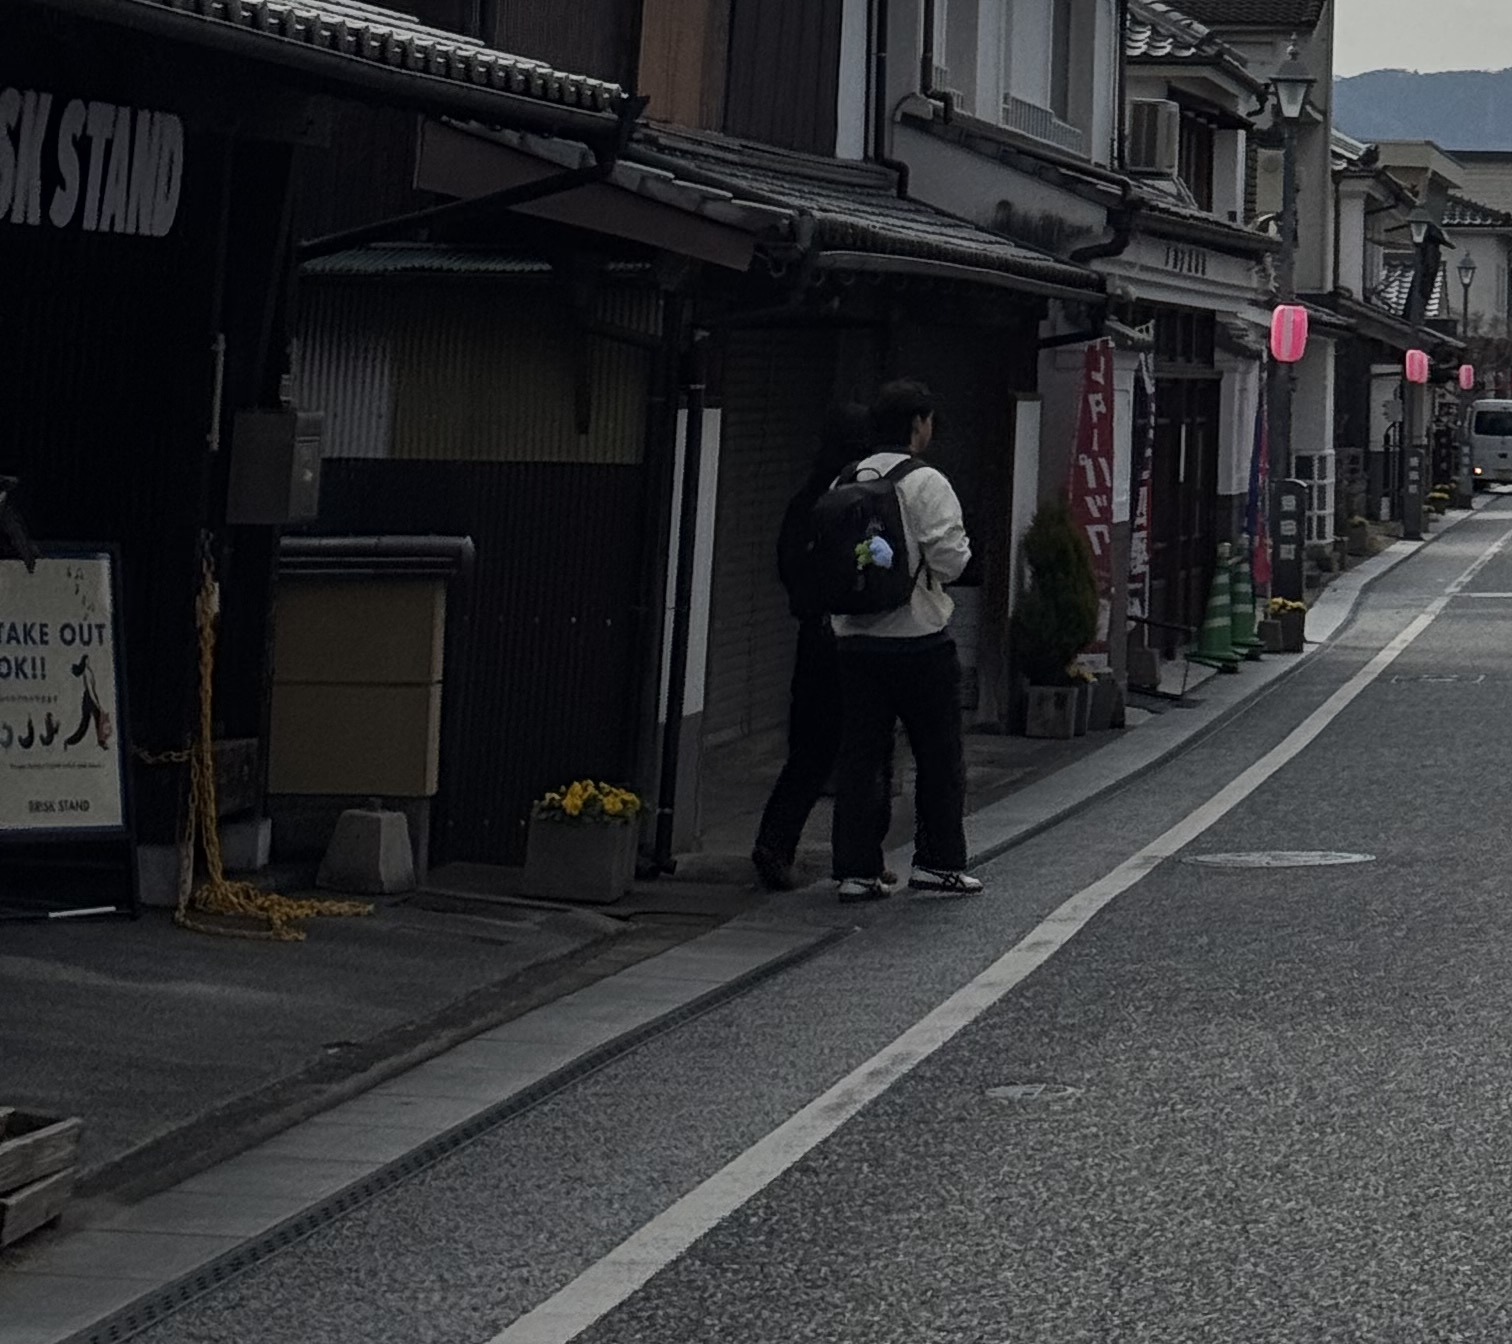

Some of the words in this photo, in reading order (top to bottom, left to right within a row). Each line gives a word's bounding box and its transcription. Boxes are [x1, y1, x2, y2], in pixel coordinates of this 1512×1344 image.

[50, 98, 185, 238] STAND
[60, 622, 106, 647] OUT
[0, 656, 46, 680] OK!!
